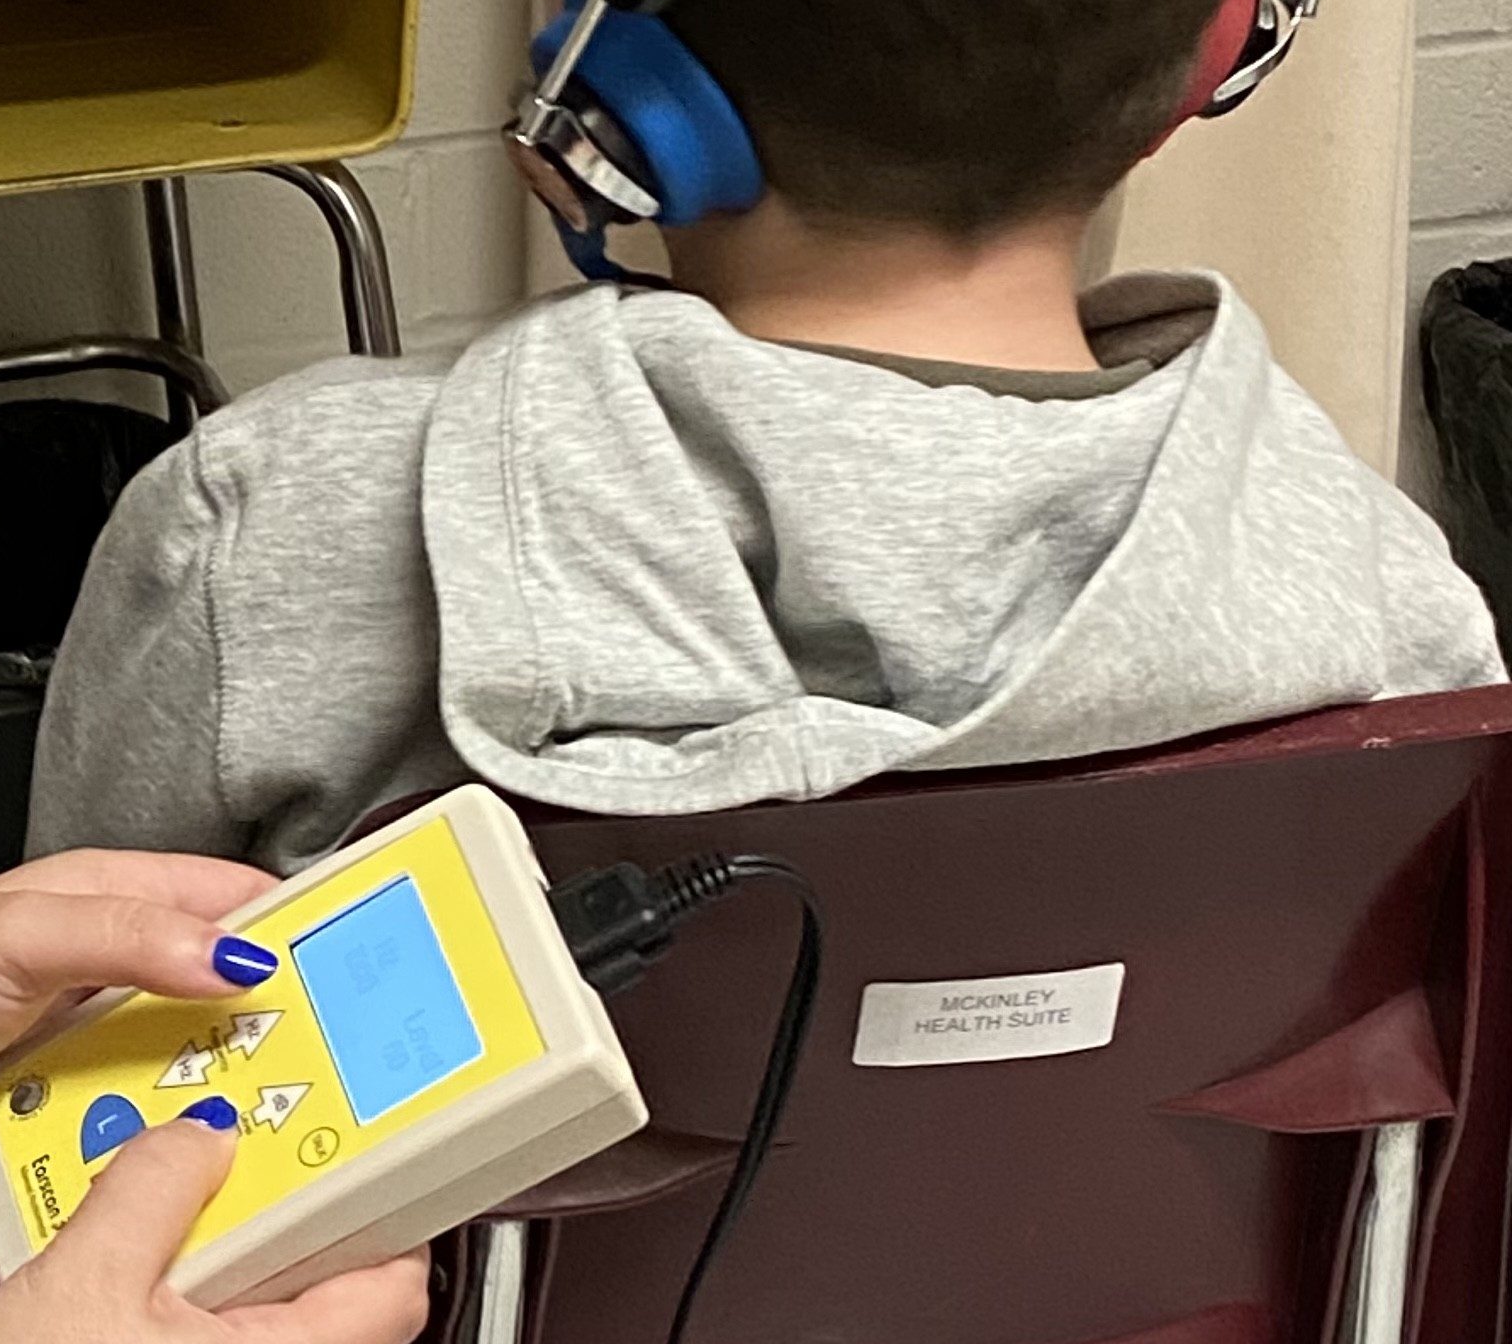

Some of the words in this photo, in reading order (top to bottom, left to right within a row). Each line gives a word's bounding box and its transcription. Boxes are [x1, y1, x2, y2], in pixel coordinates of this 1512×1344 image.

[938, 988, 1057, 1013] MCKINLEY
[913, 1013, 1002, 1035] HEALTH
[1007, 1007, 1073, 1029] SUITE
[97, 1114, 119, 1135] L
[31, 1154, 61, 1219] Earscan
